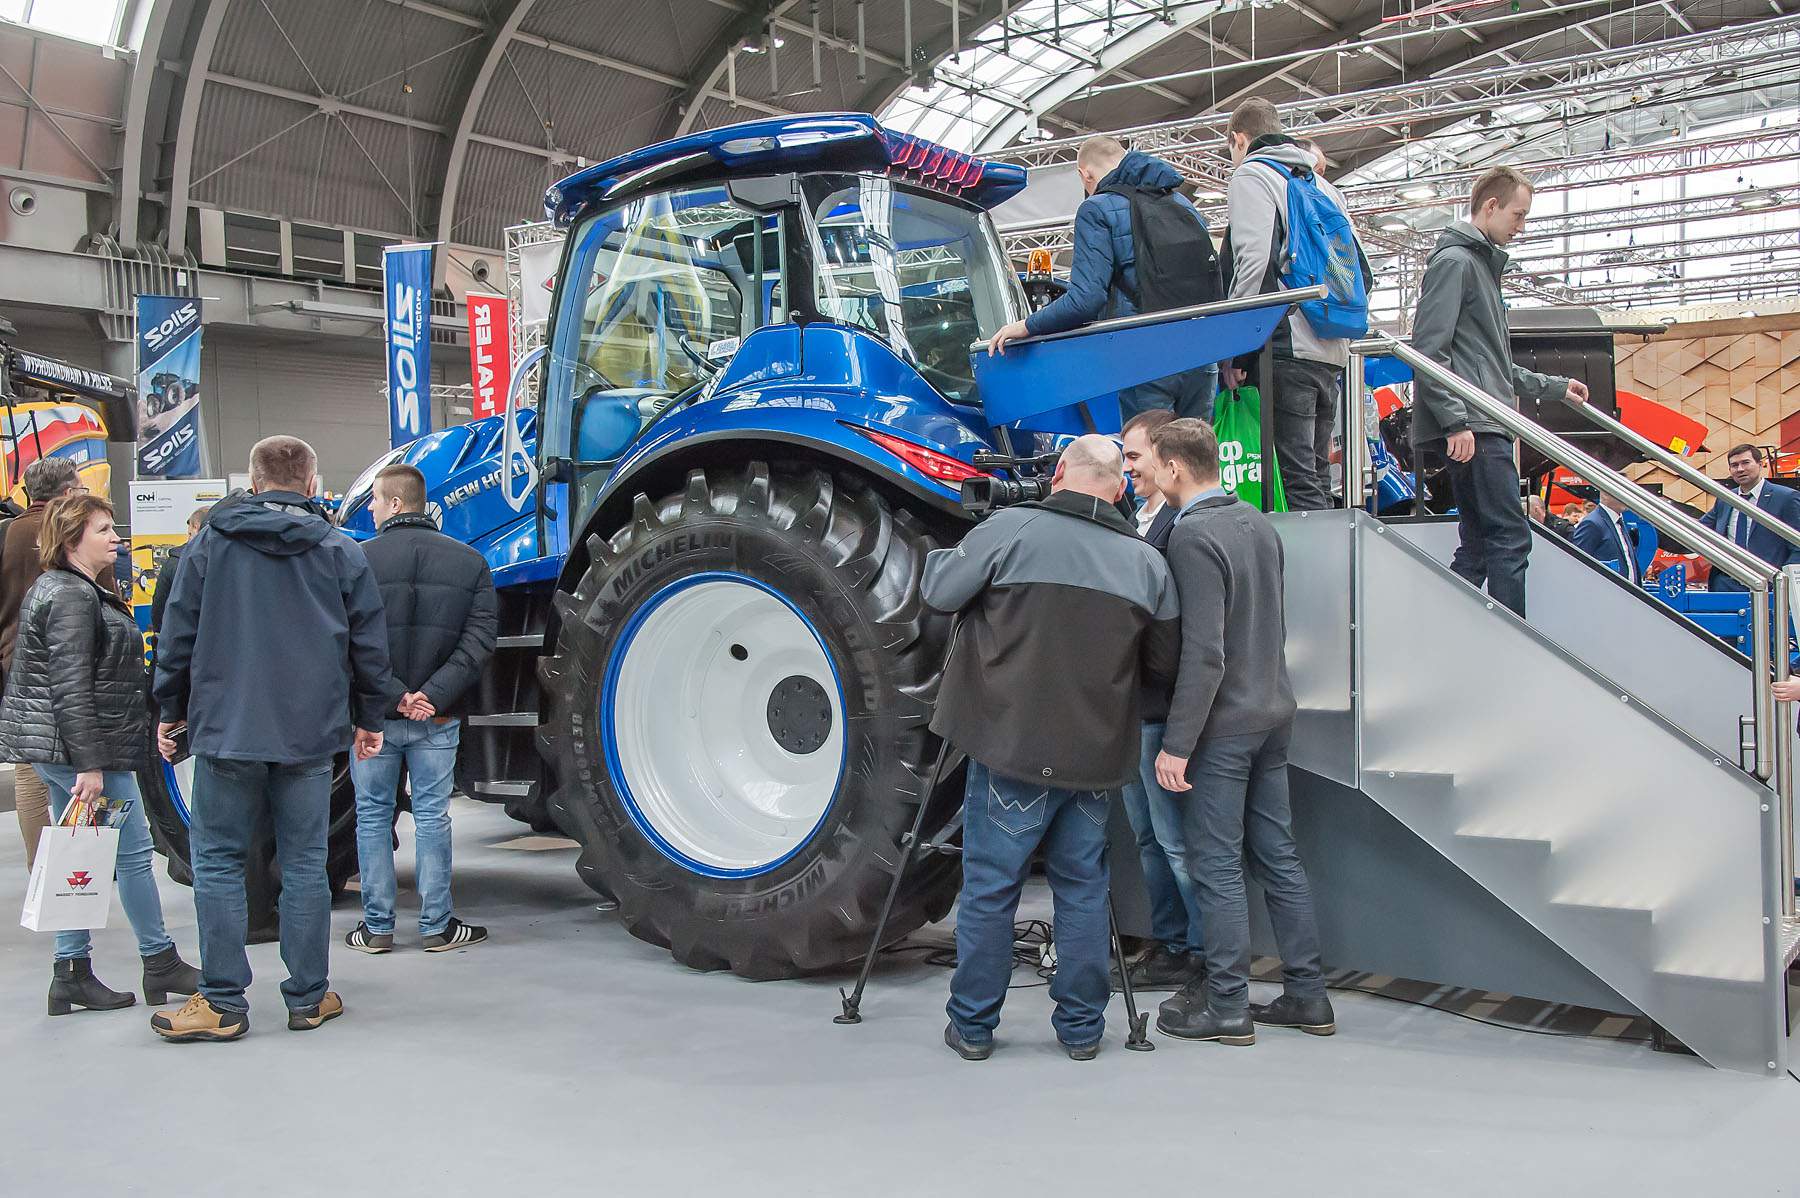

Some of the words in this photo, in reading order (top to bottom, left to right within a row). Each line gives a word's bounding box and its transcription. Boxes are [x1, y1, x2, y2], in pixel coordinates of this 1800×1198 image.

[474, 303, 496, 416] HALER
[443, 479, 481, 510] NEW
[611, 530, 732, 598] MICHELIN
